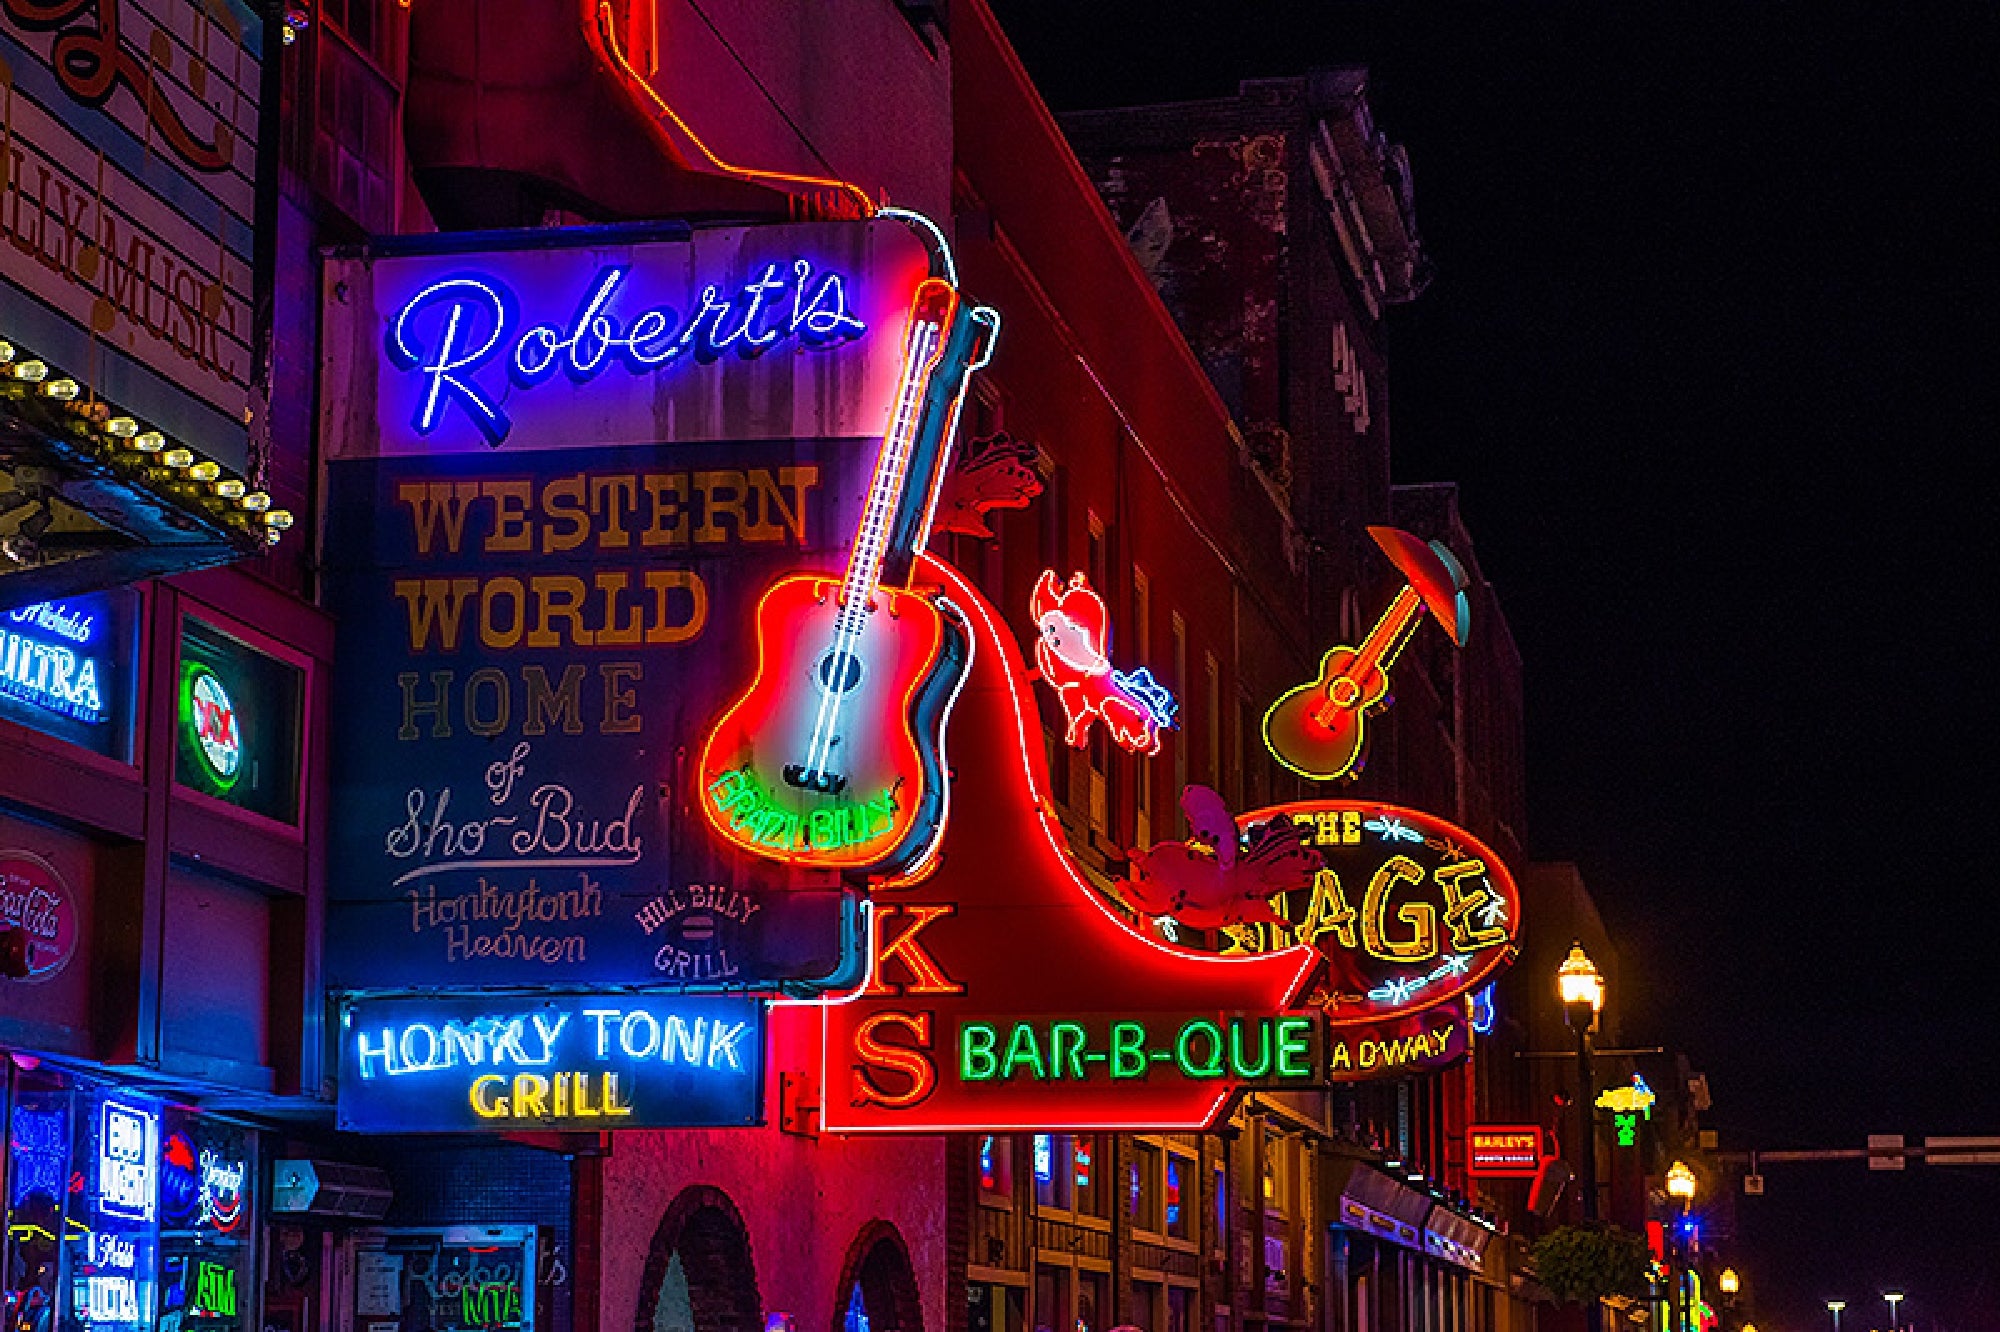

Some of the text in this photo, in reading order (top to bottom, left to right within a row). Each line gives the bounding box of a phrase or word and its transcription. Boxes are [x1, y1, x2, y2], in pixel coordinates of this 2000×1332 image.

[388, 256, 868, 444] Robert's
[398, 466, 819, 554] WESTERN
[395, 571, 710, 650] WORLD
[398, 662, 644, 741] HOME
[484, 741, 531, 806] of
[445, 923, 586, 963] Heaven
[634, 889, 686, 936] HILL
[654, 943, 739, 980] GRILL
[357, 1009, 753, 1079] HONKY TONK
[958, 1017, 1313, 1082] BAR-B-QUE
[469, 1071, 633, 1119] GRILL
